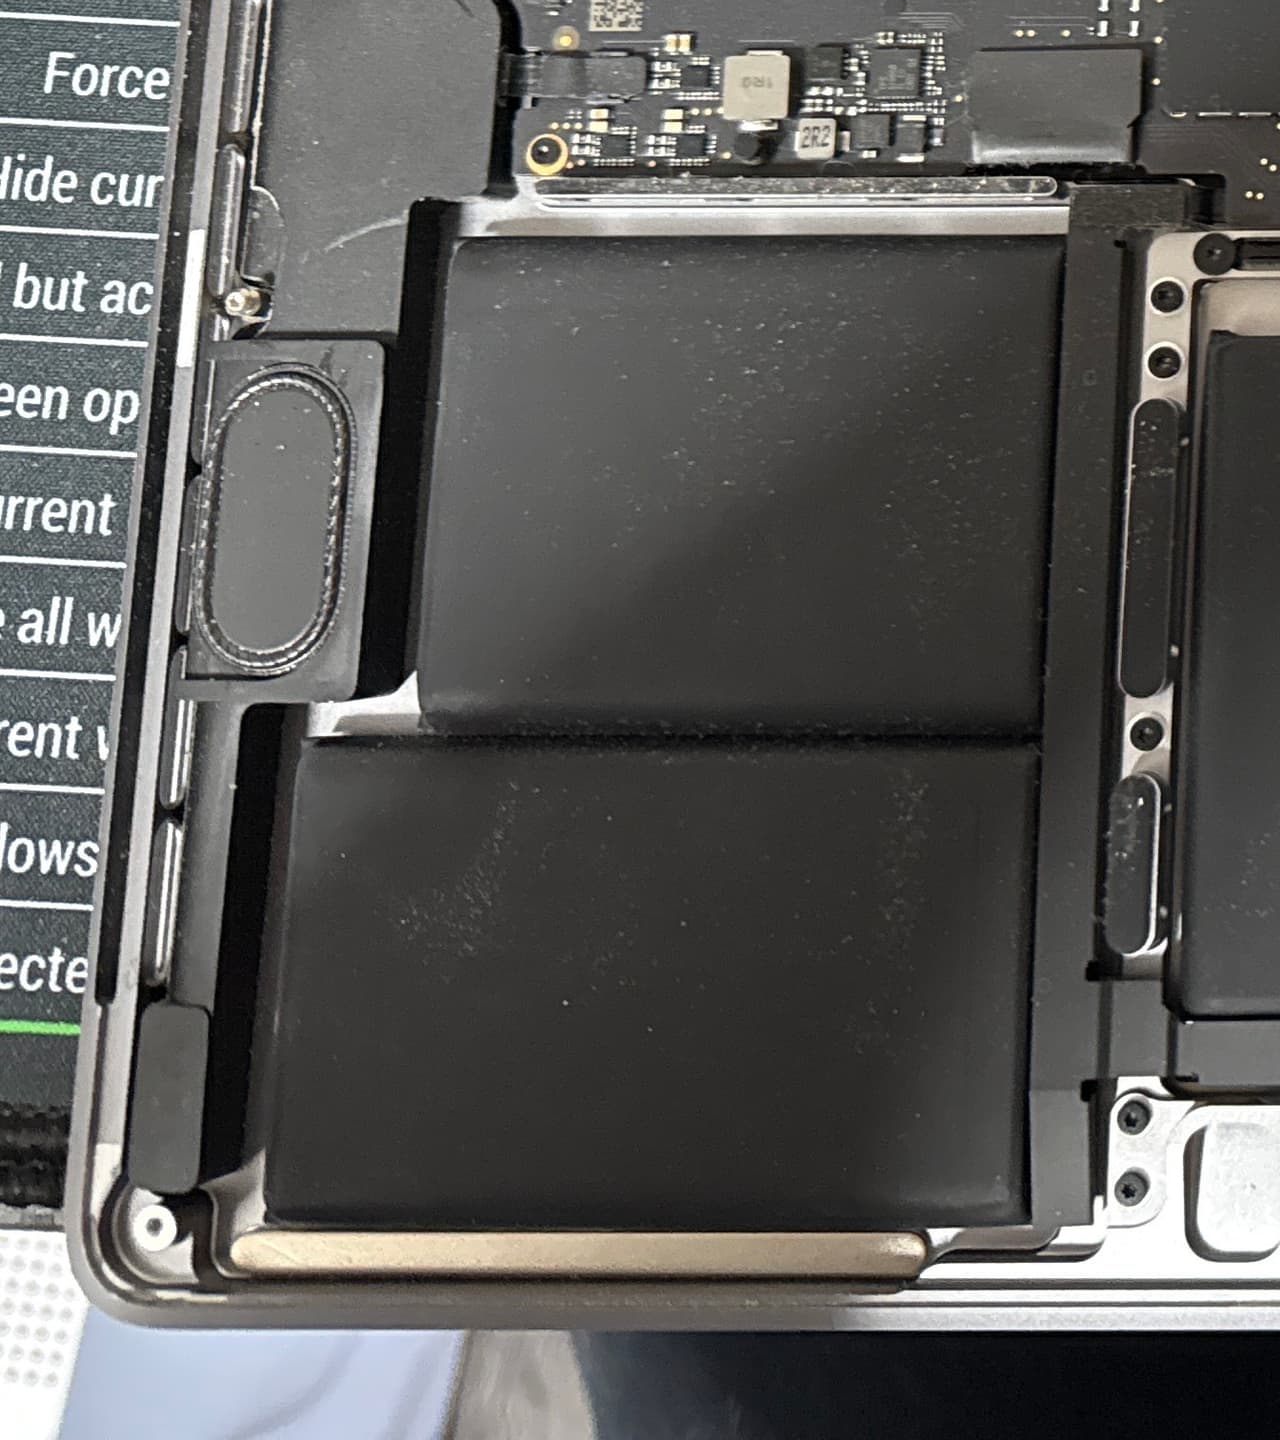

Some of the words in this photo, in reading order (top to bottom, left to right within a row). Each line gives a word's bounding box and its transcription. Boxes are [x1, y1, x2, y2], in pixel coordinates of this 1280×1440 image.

[43, 51, 169, 100] Force
[801, 126, 831, 148] 2R2
[13, 262, 88, 313] but
[17, 596, 75, 647] all
